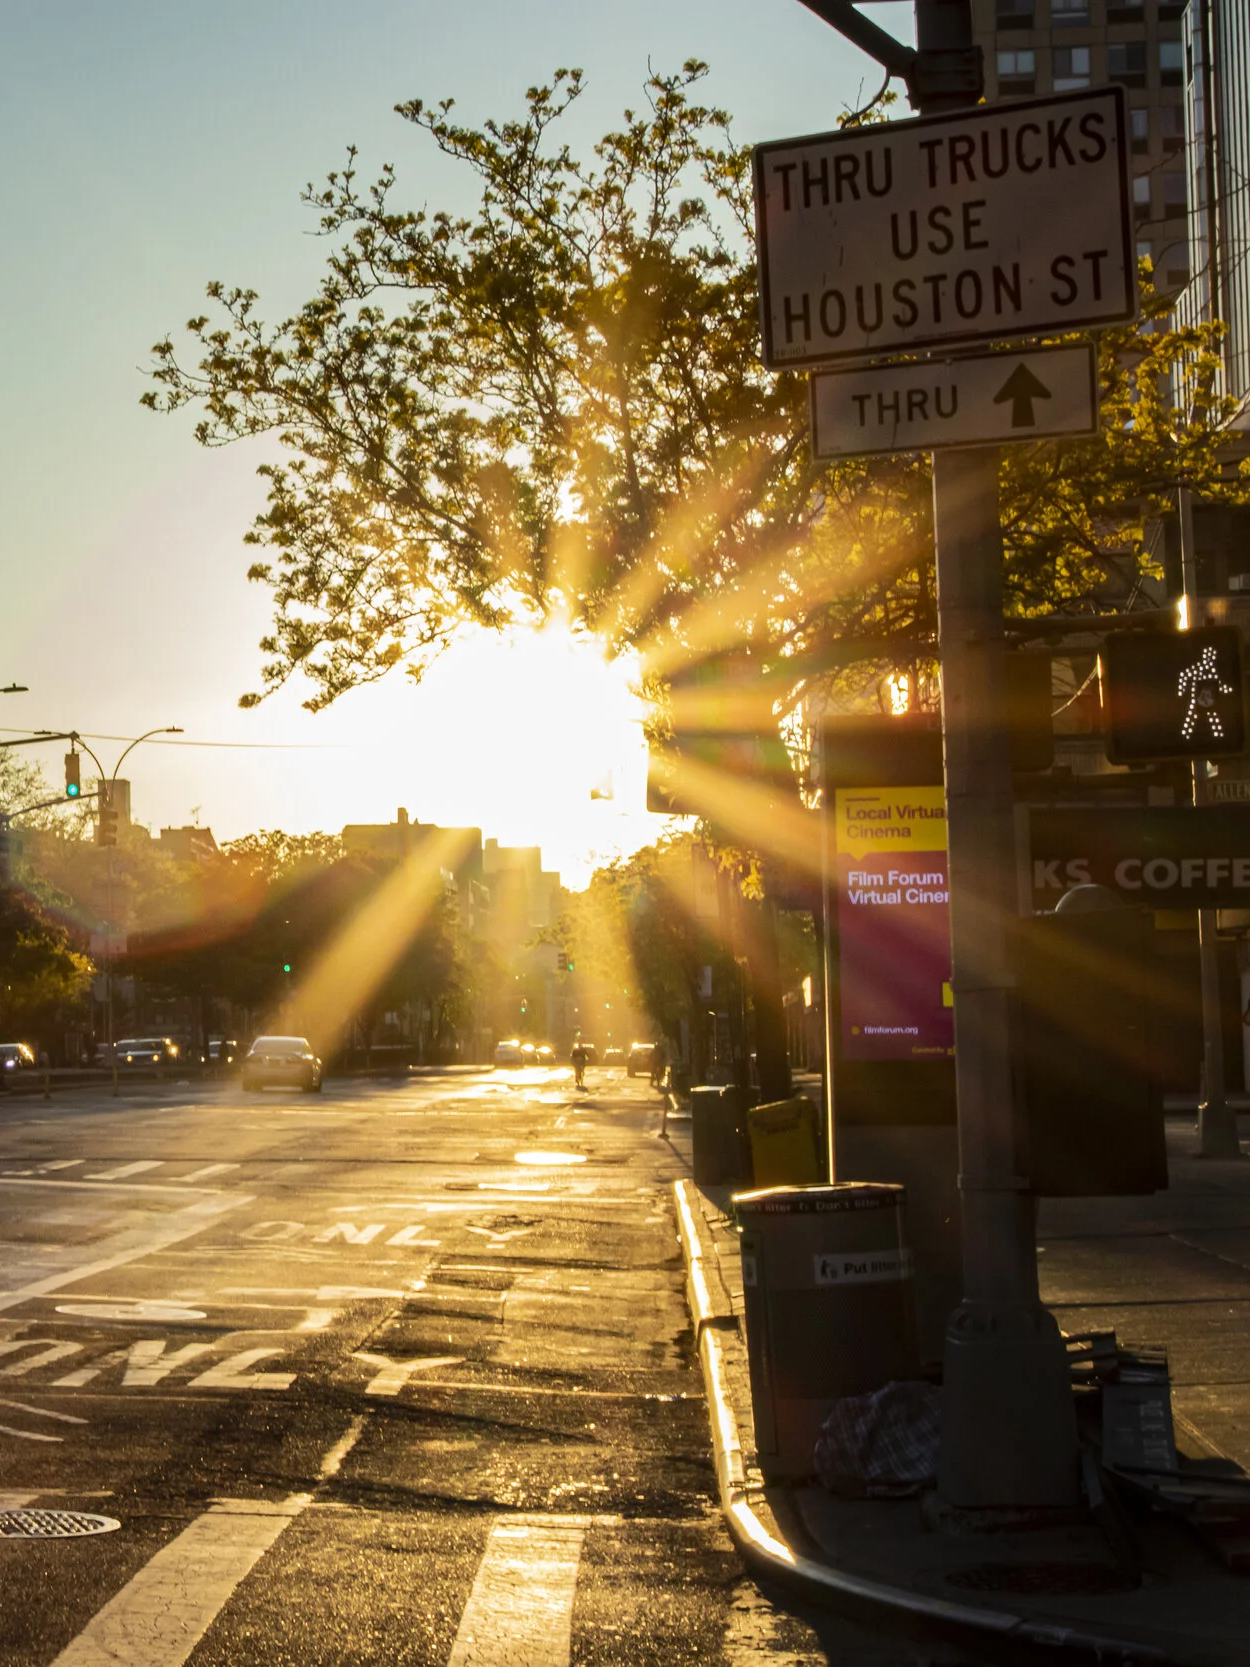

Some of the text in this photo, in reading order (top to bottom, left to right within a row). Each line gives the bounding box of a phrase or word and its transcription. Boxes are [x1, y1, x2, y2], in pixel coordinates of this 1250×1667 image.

[773, 112, 1107, 212] THRU TRUCKS
[890, 199, 989, 261] USE
[783, 249, 1108, 345] HOUSTON ST
[851, 384, 959, 428] THRU
[846, 804, 948, 821] Local Virtua
[846, 824, 912, 839] Cinema
[847, 869, 944, 887] Film Forum
[1033, 858, 1250, 890] KS COFFE
[847, 888, 902, 905] Virtual
[864, 1025, 919, 1036] filmforum.org
[816, 1200, 850, 1212] Don't
[240, 1220, 535, 1250] ONLY
[843, 1261, 868, 1275] Put
[871, 1259, 897, 1272] litter
